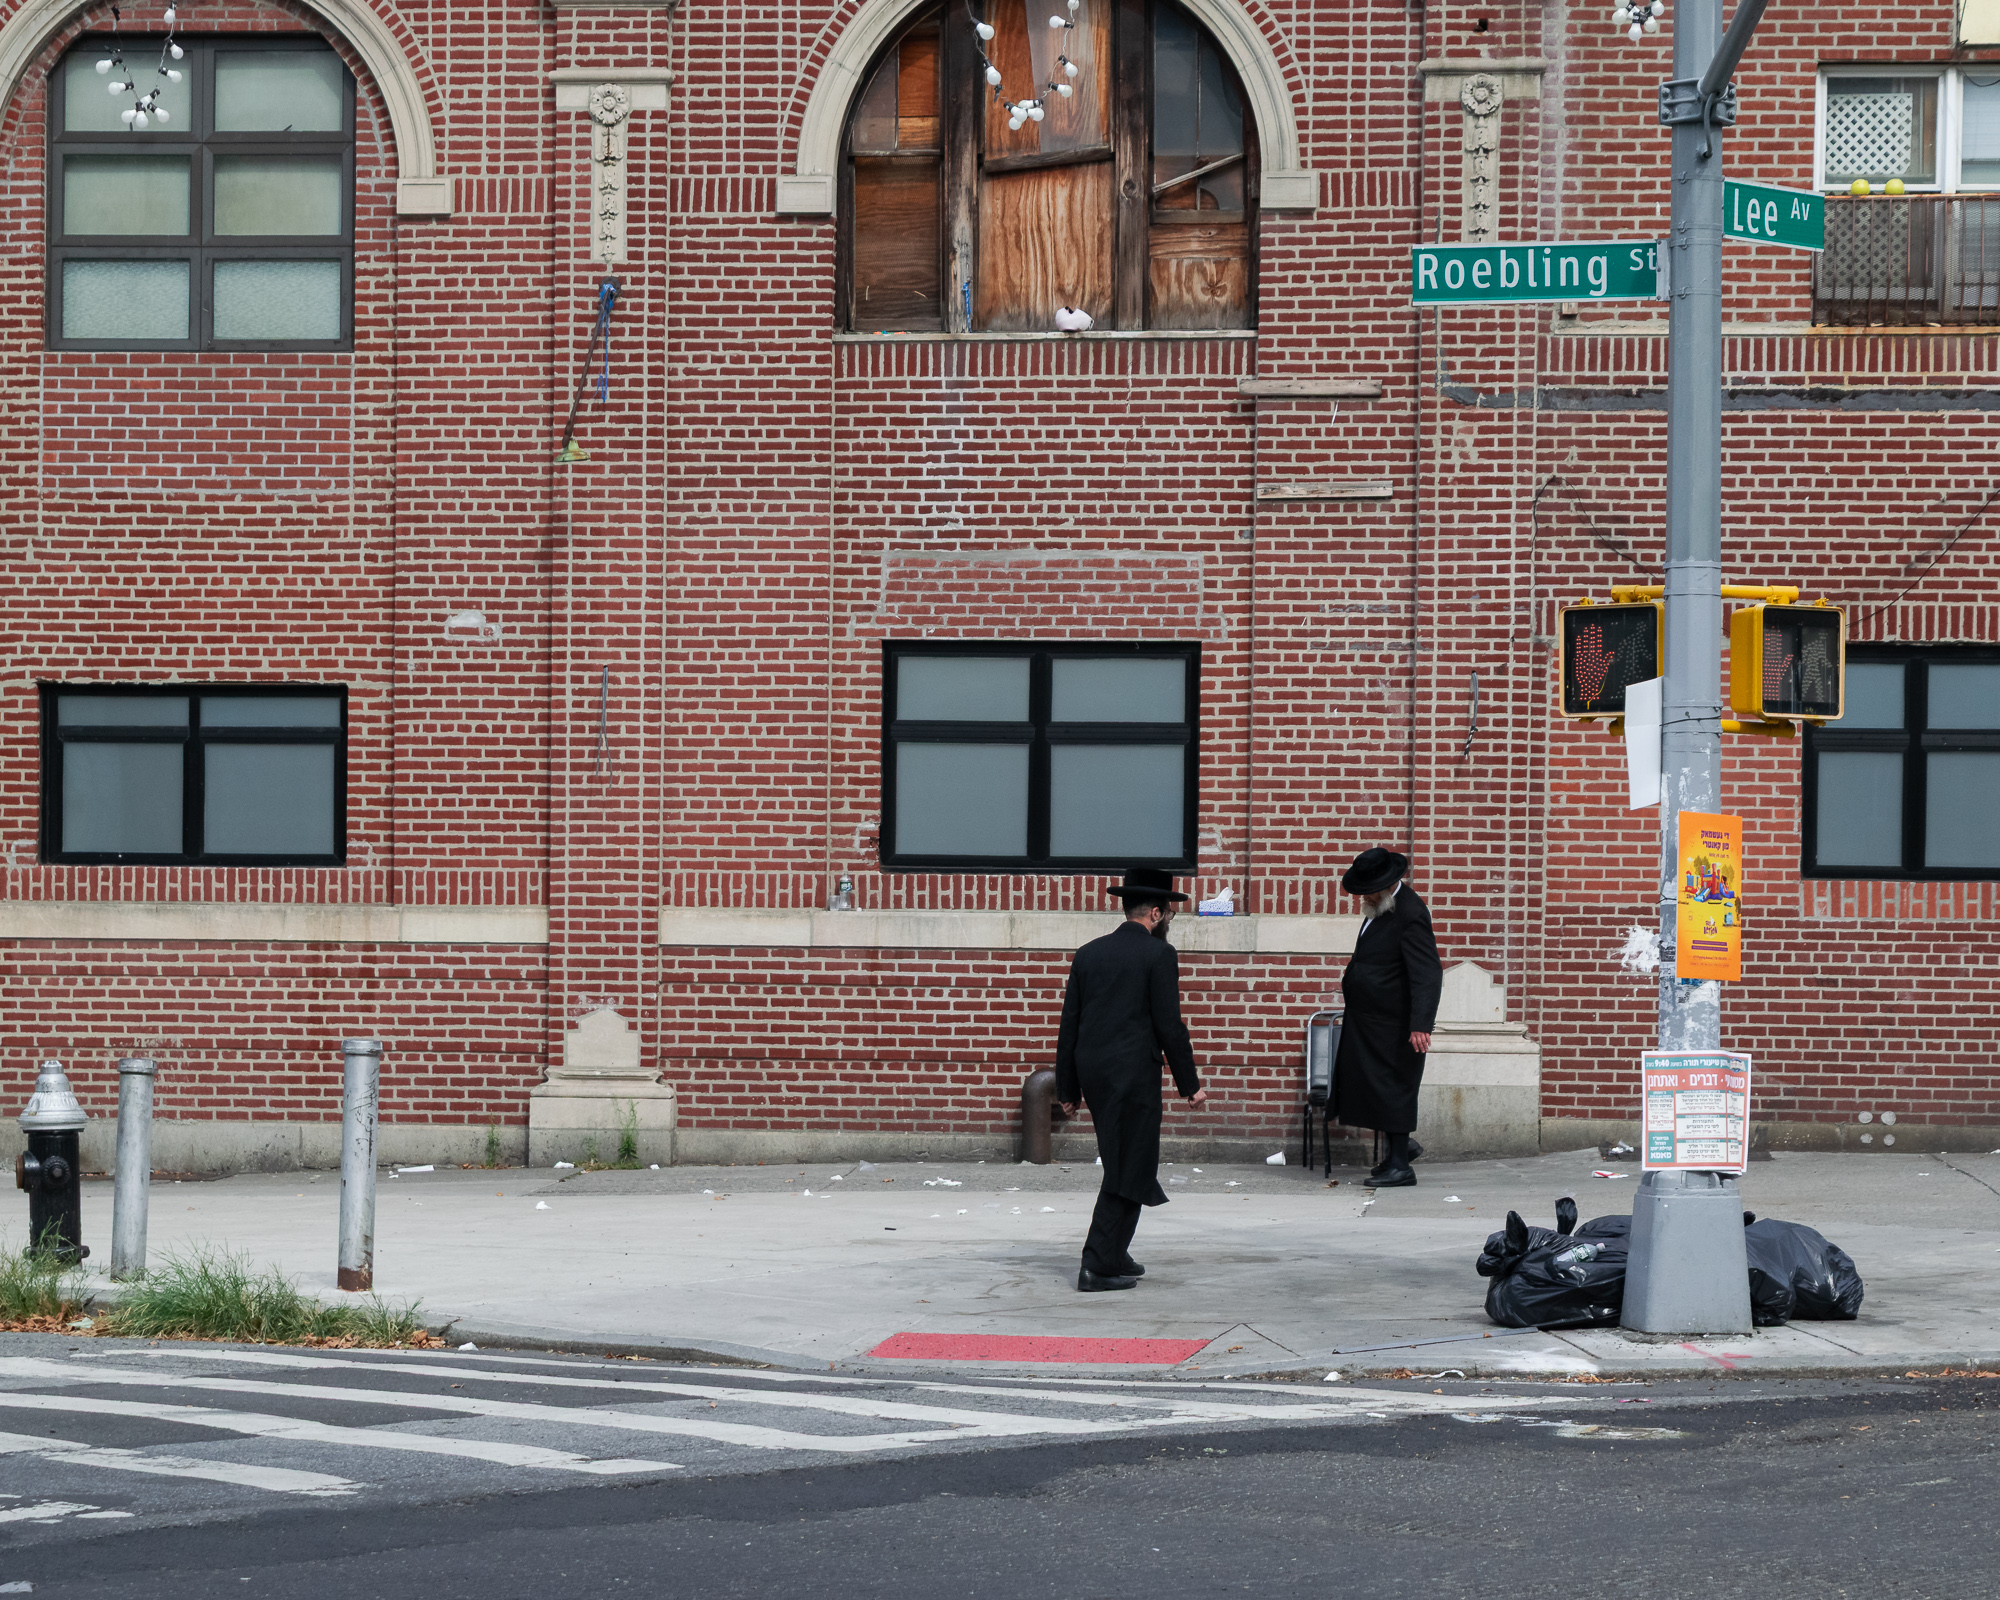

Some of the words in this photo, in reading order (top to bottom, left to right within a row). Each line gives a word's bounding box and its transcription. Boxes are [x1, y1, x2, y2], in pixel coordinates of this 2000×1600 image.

[1733, 188, 1778, 236] Lee
[1790, 197, 1811, 221] Av
[1418, 247, 1608, 297] Roebling
[1629, 248, 1657, 272] St
[1654, 1059, 1670, 1067] 9:40
[1683, 1059, 1699, 1067] תורה
[1700, 1058, 1719, 1067] שיעורי
[1647, 1074, 1679, 1090] ואתחנן
[1689, 1073, 1718, 1086] דברים
